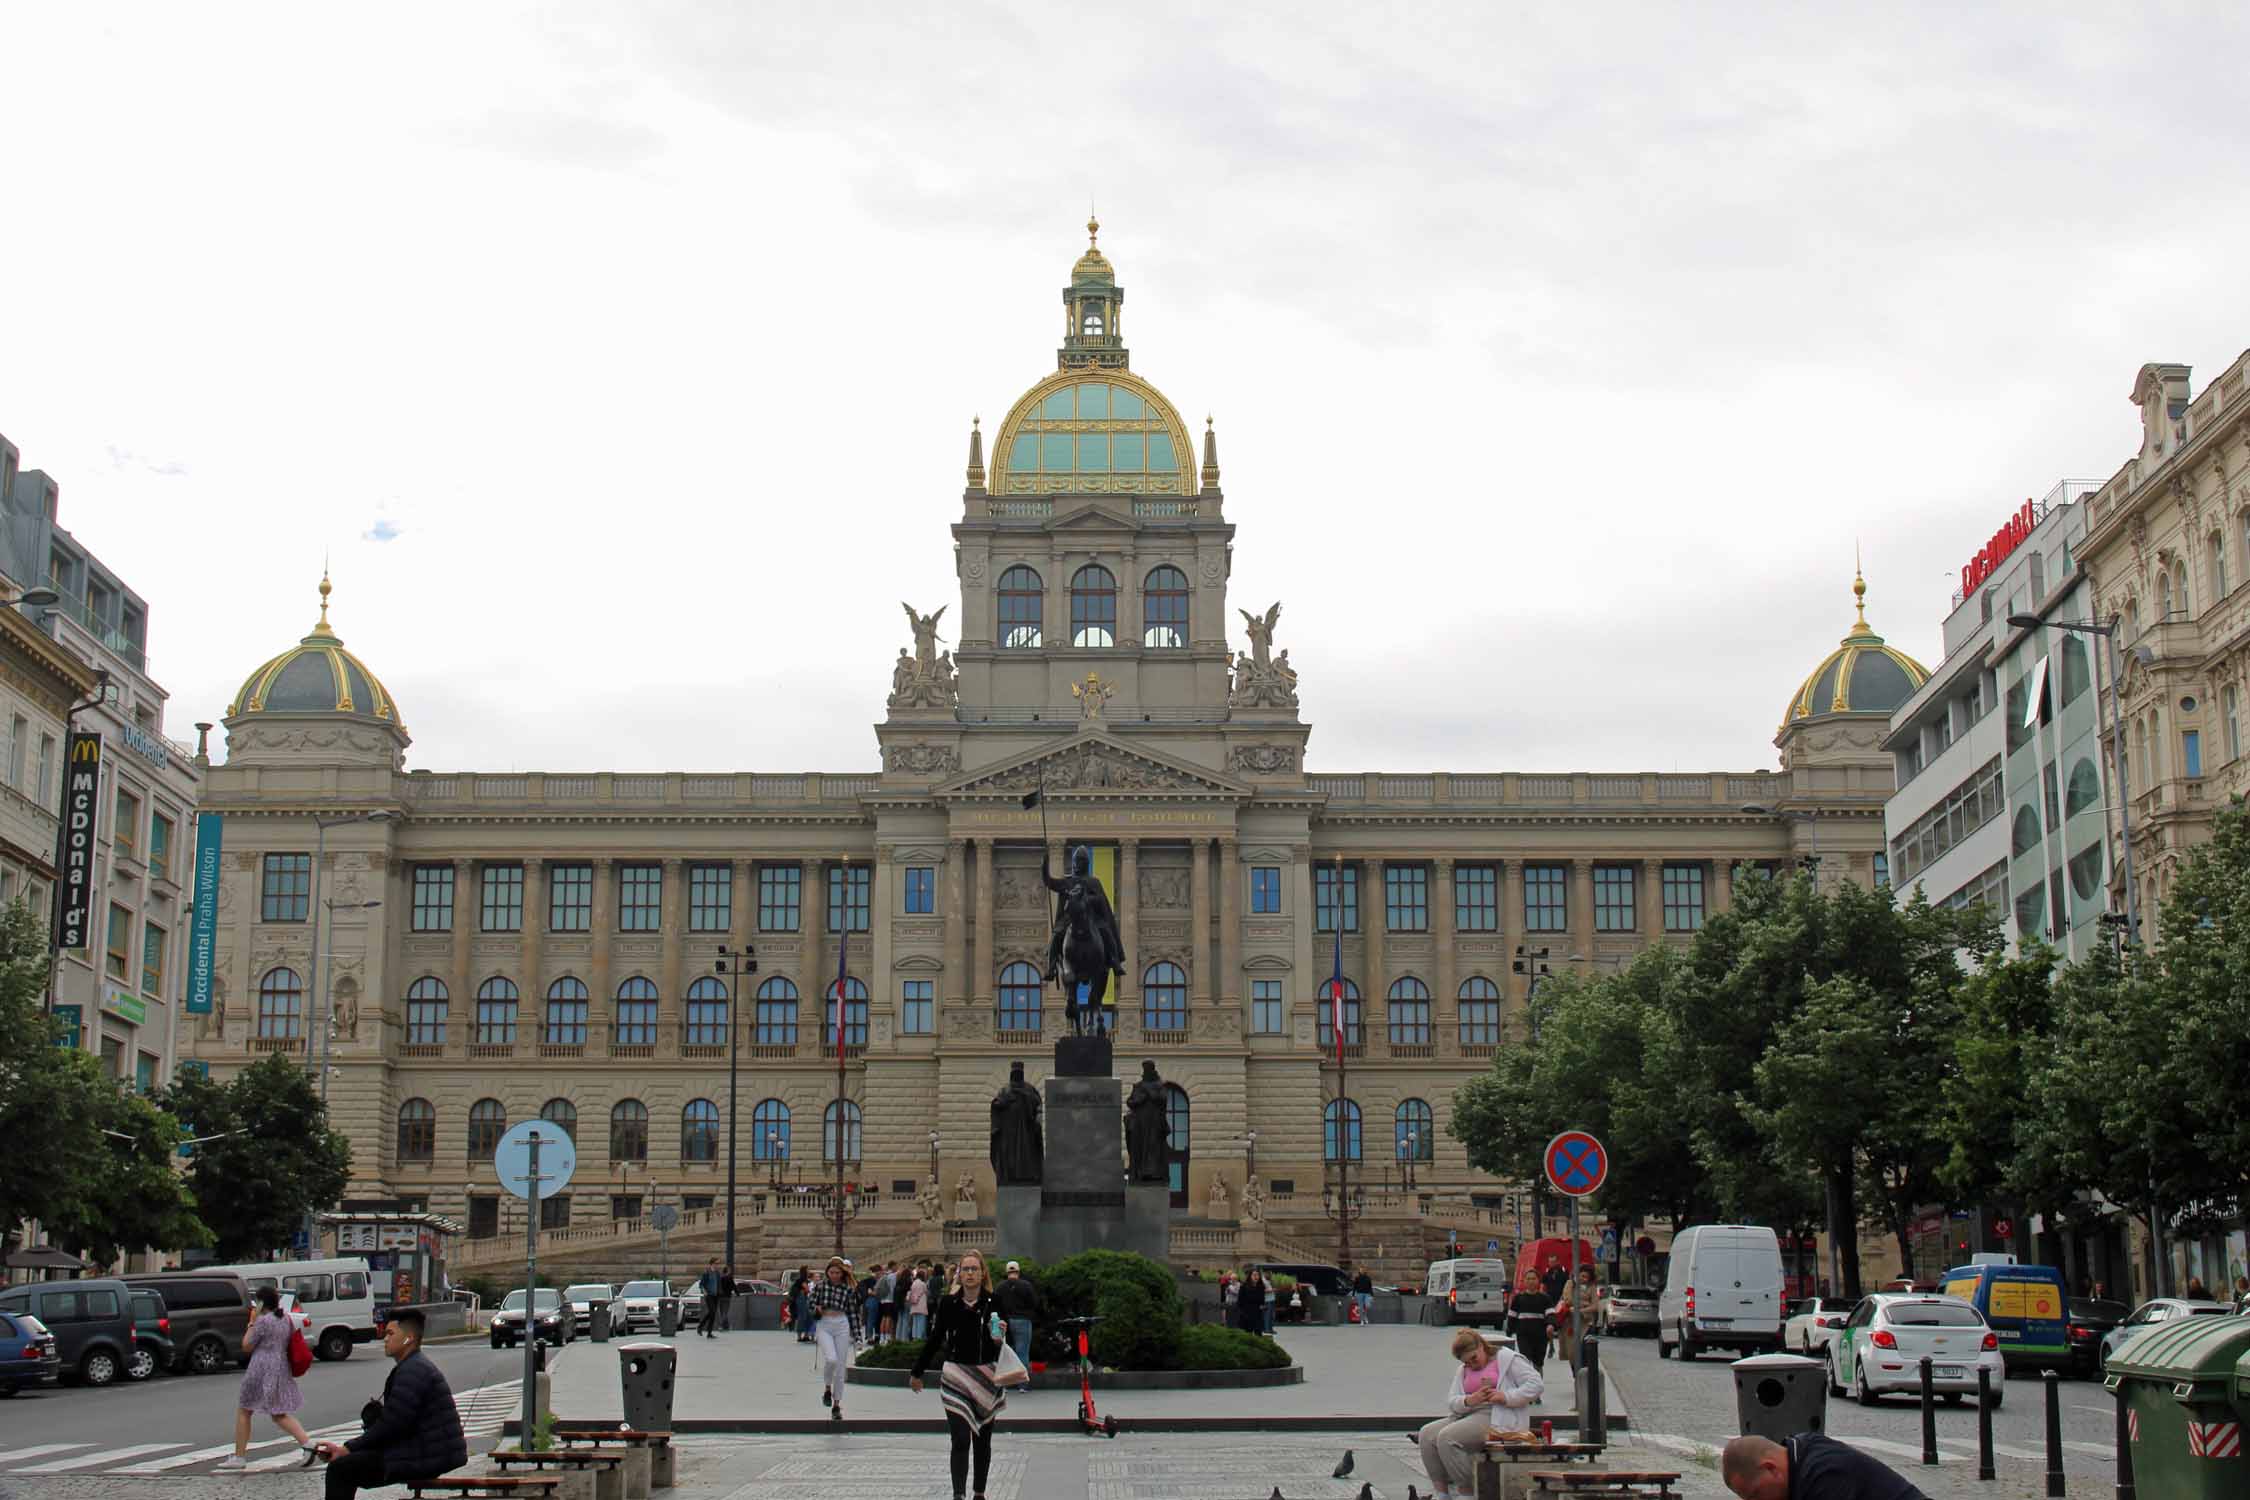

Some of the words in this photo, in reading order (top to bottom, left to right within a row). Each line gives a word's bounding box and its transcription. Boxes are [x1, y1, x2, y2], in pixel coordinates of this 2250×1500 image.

[66, 773, 93, 945] McDonald's
[201, 847, 216, 892] Wilson
[199, 893, 213, 929] Praha
[194, 932, 210, 1003] Occidental
